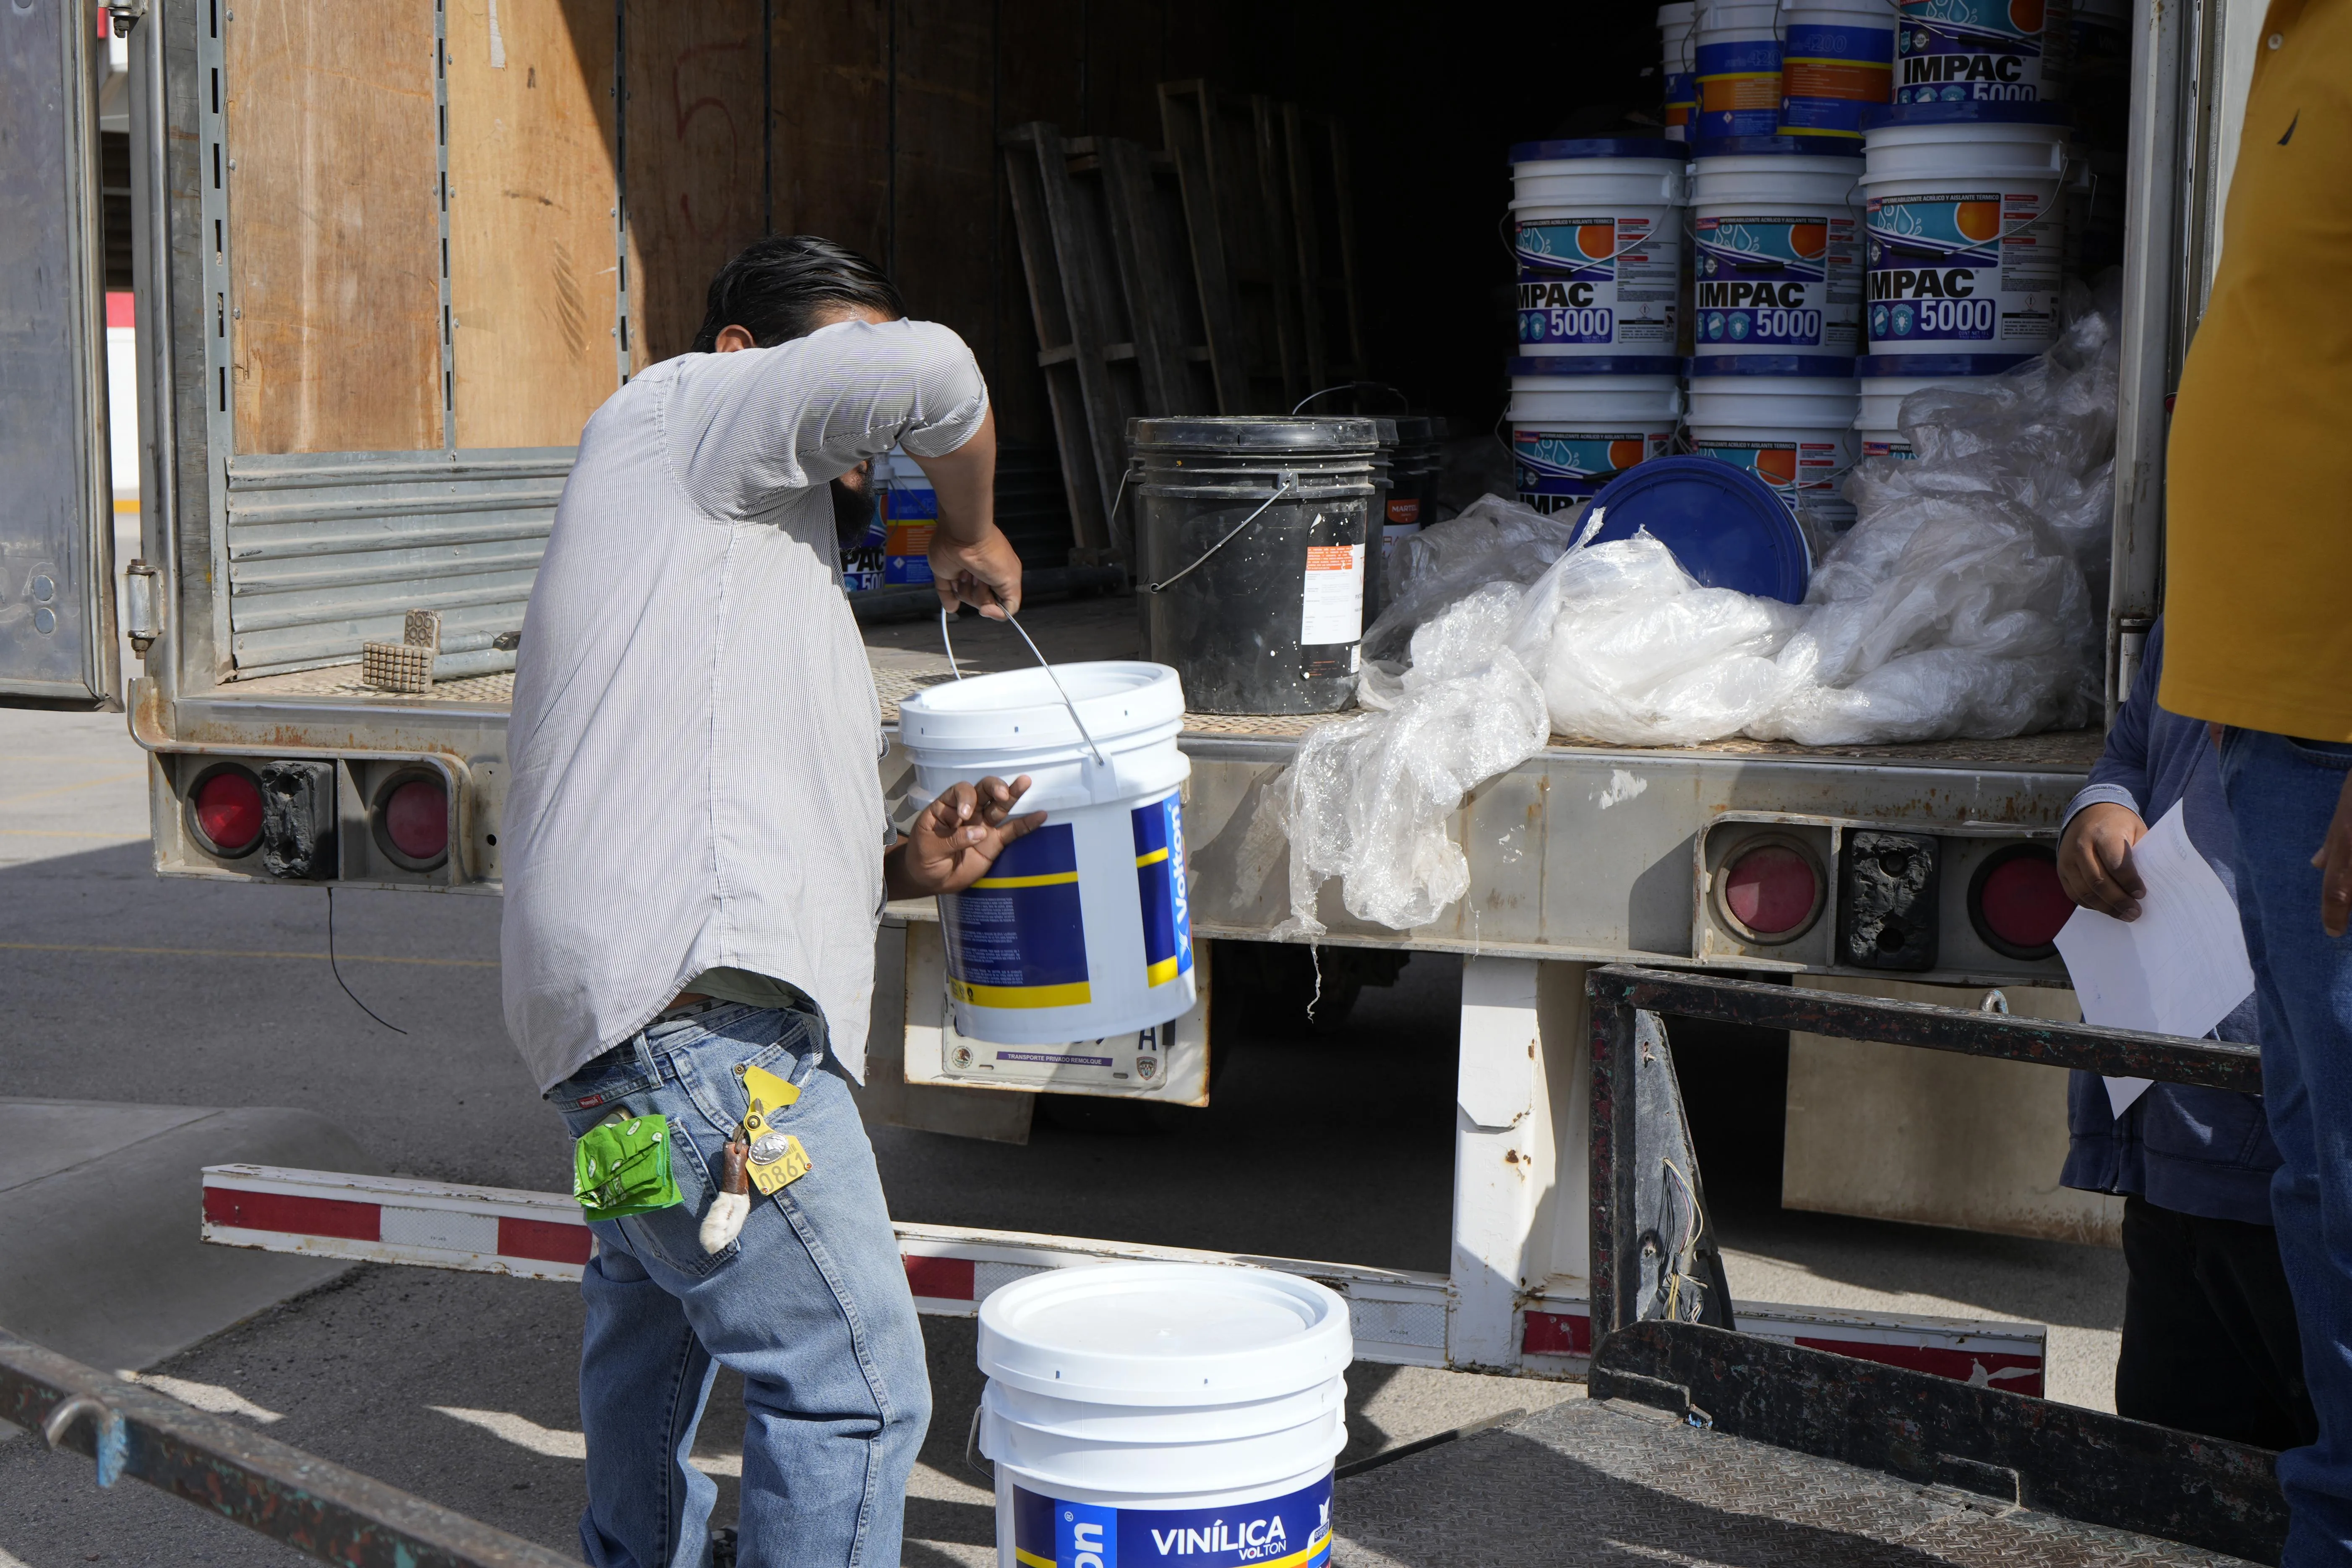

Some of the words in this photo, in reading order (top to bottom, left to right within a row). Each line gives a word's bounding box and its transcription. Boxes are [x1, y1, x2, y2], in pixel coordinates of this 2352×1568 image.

[1804, 34, 1847, 52] 4200
[1904, 55, 2022, 84] IMPAC
[1700, 282, 1805, 308] IMPAC
[1551, 310, 1610, 336] 5000
[1756, 310, 1818, 337] 5000
[1920, 300, 1992, 331] 5000
[1171, 804, 1187, 925] Volton
[759, 1152, 806, 1192] 0861
[1151, 1515, 1286, 1555] VINÍLICA
[1238, 1539, 1287, 1560] VOLTON
